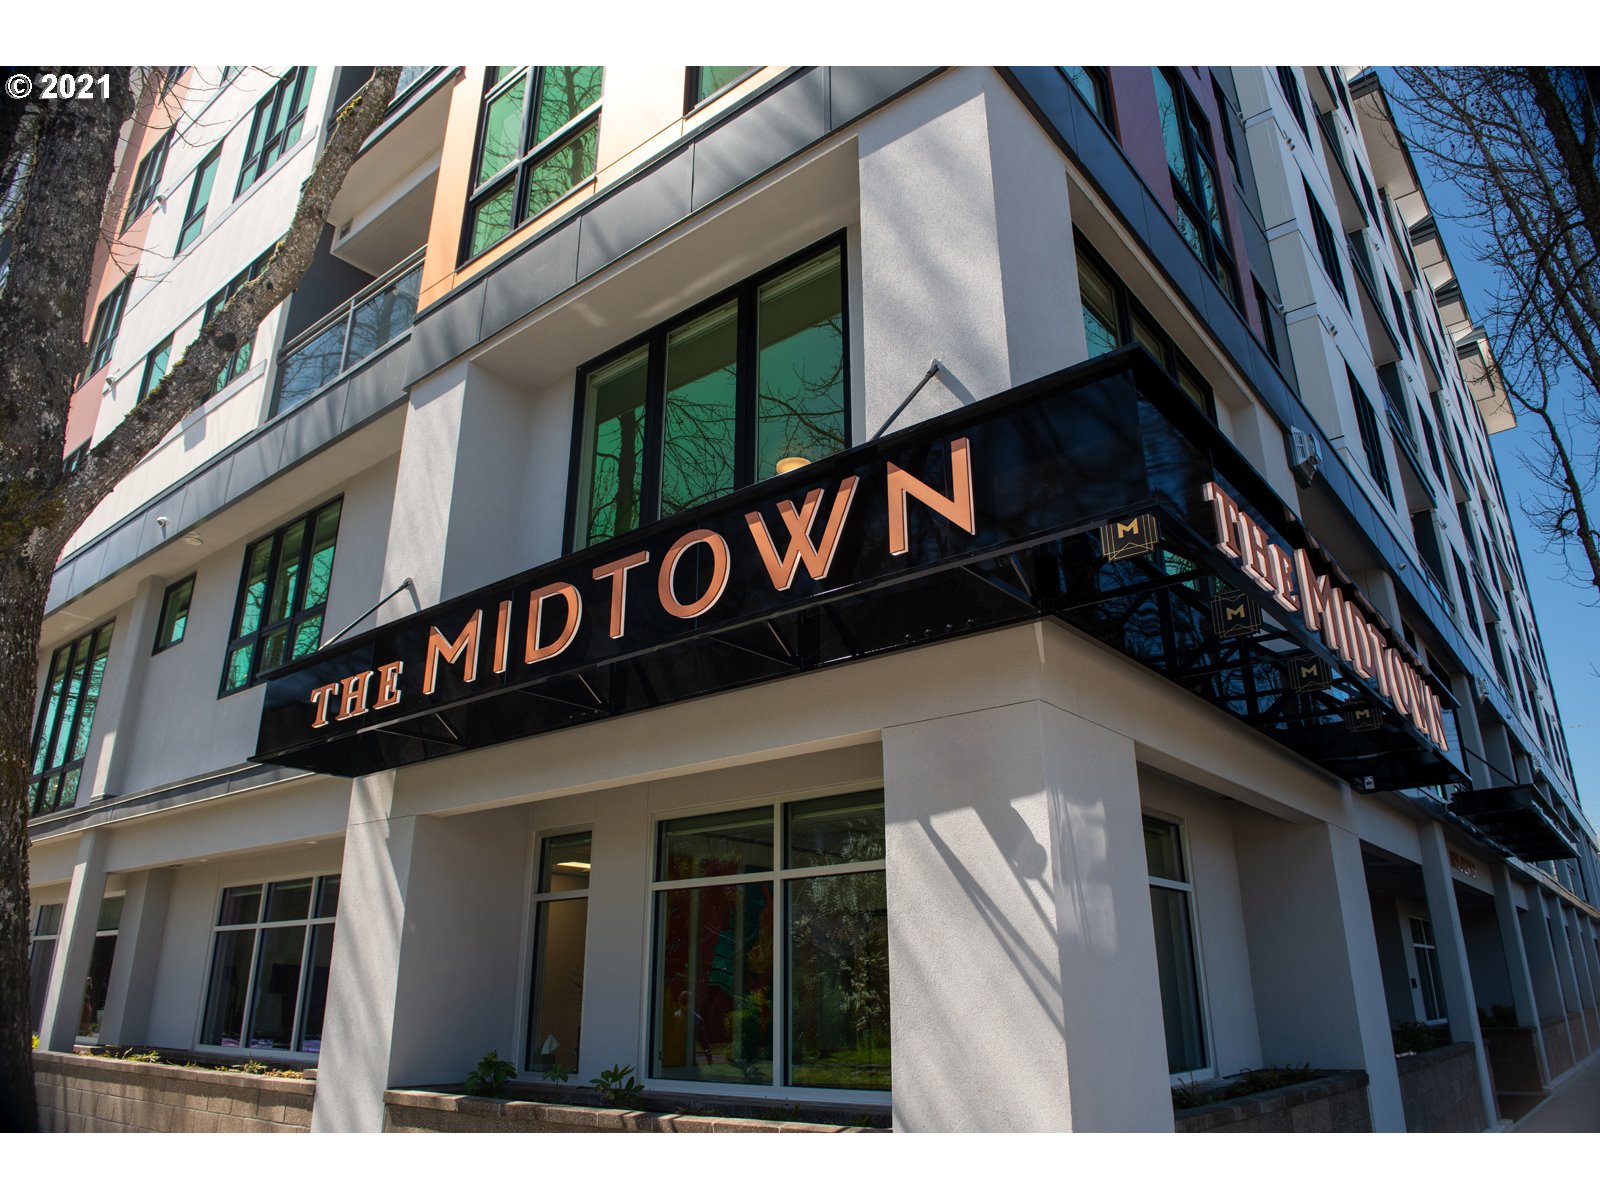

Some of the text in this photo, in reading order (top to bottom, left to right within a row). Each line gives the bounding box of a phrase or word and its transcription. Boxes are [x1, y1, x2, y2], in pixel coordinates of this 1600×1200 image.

[1117, 518, 1139, 538] M
[310, 437, 976, 728] THE MIDTOWN
[1203, 482, 1449, 751] THE MIDTOWN
[1226, 604, 1246, 621] M
[1301, 664, 1318, 678] M
